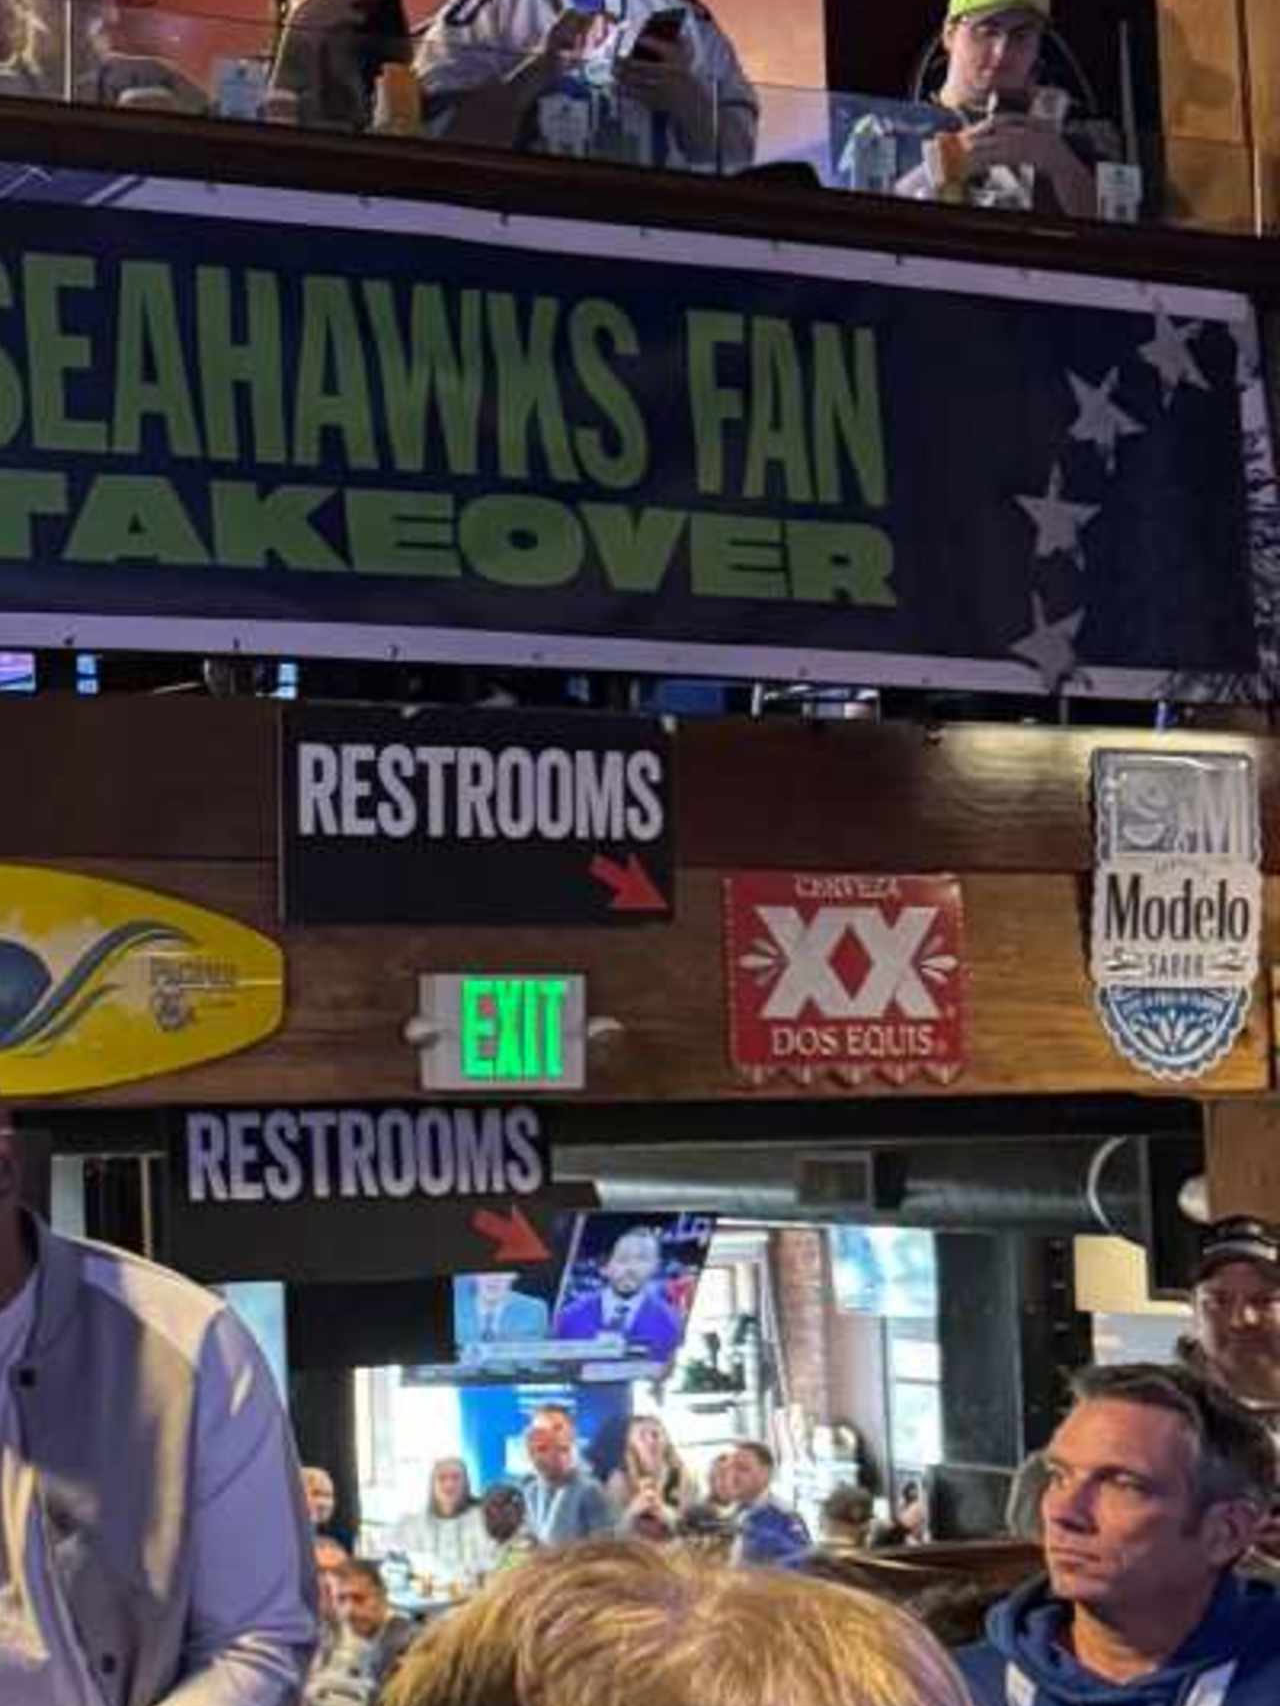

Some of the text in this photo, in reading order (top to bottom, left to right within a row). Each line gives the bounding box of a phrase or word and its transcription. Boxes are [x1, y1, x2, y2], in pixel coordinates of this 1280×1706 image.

[686, 308, 890, 506] FAN
[298, 742, 664, 841] RESTROOMS
[1105, 872, 1251, 943] Modelo
[754, 905, 942, 1020] XX
[460, 978, 567, 1079] EXIT
[771, 1024, 935, 1058] DOS EQUIS
[187, 1106, 543, 1202] RESTROOMS
